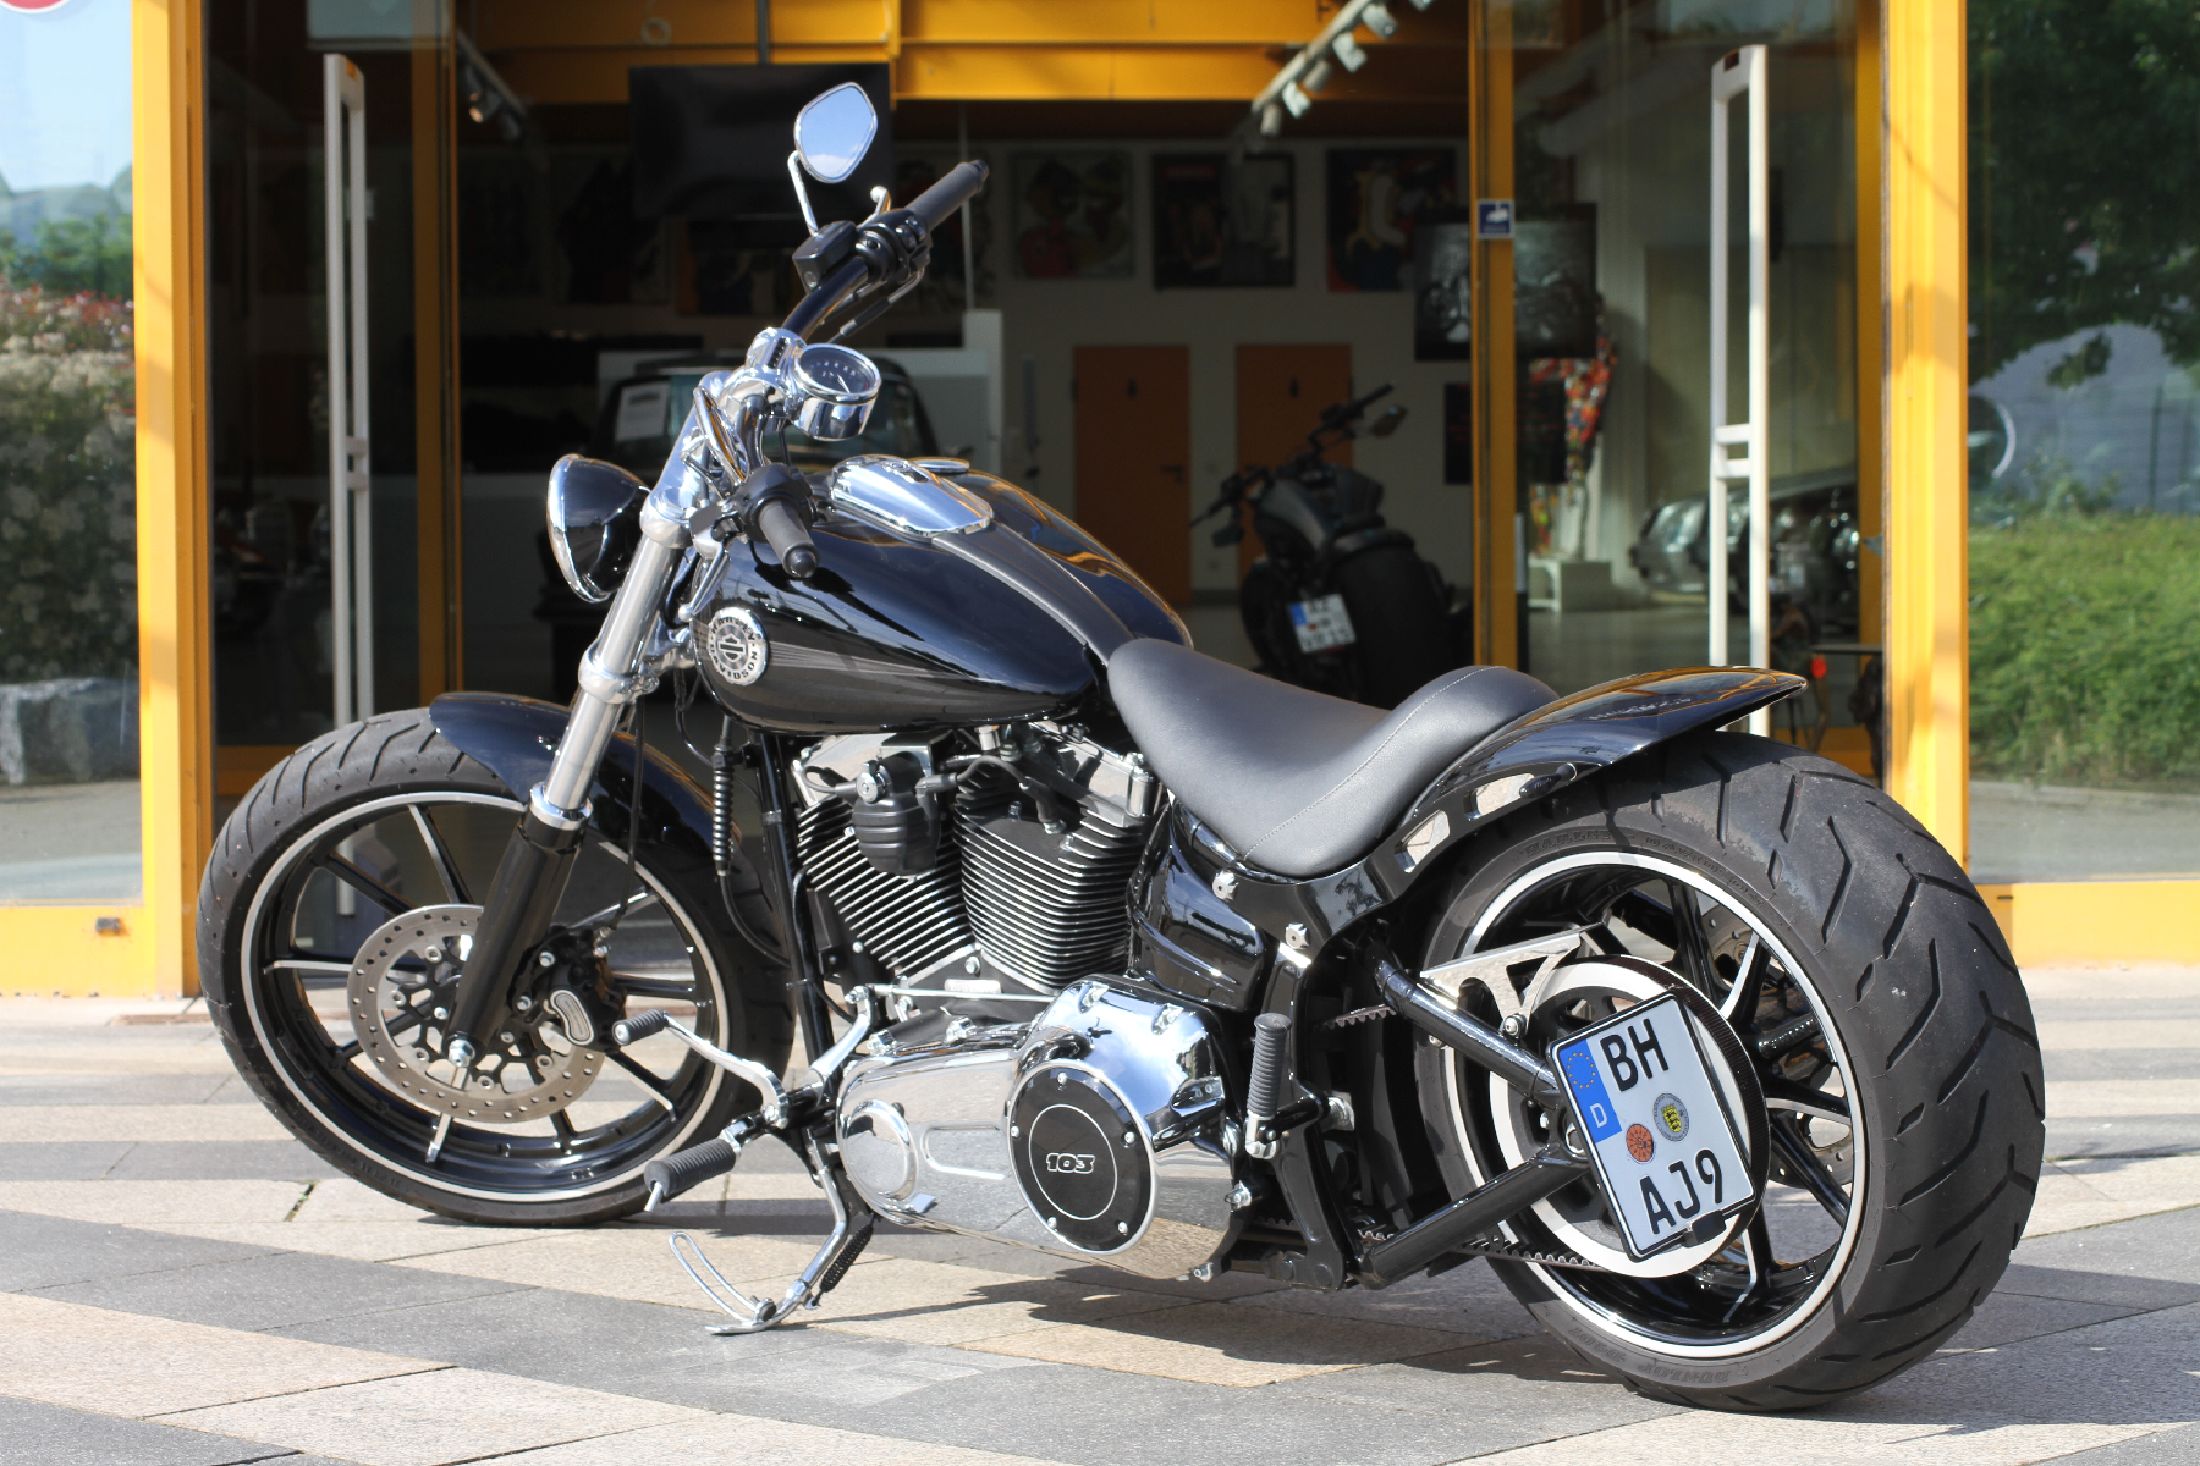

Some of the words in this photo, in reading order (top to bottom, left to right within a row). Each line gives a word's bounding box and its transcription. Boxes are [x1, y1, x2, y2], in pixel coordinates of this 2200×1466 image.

[1600, 1018, 1669, 1092] BH
[1589, 1103, 1608, 1129] D
[1046, 1153, 1095, 1174] 103
[1639, 1149, 1723, 1235] AJ9
